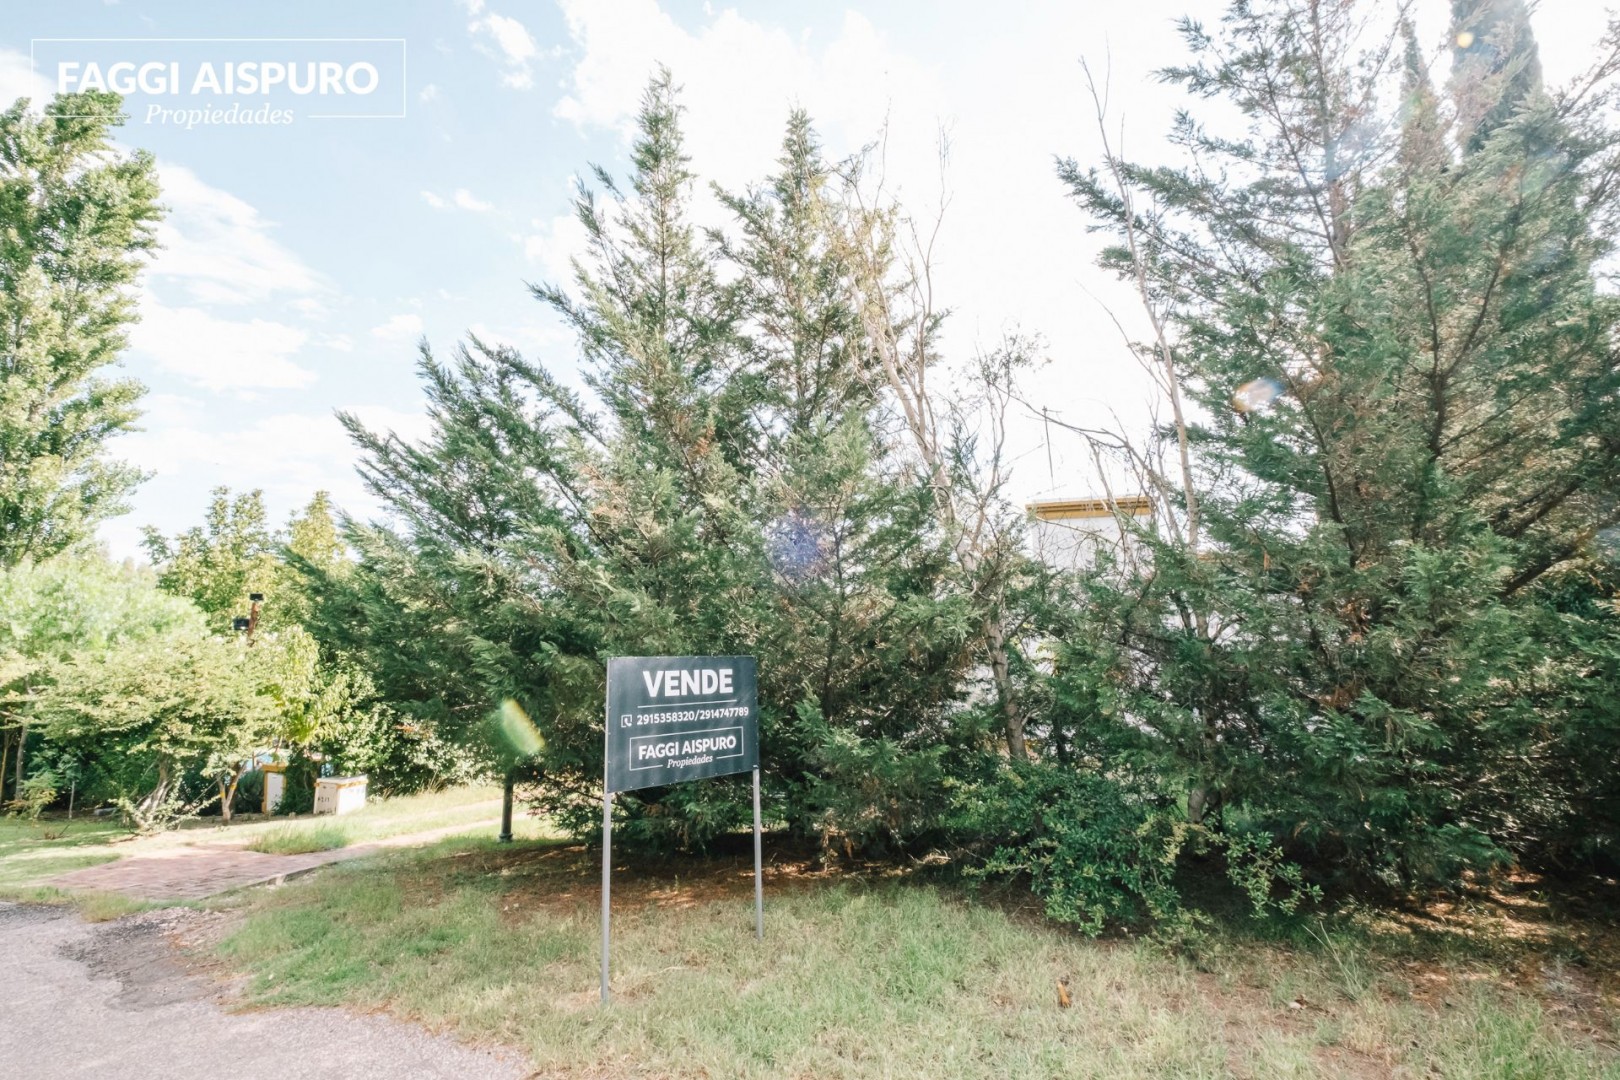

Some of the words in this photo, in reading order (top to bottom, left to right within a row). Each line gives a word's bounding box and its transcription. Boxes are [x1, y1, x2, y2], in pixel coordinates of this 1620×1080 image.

[643, 669, 733, 697] VENDE
[637, 707, 749, 725] 2915358320/2914747789
[638, 742, 679, 760] FAGGI
[681, 735, 737, 755] AISPURO
[667, 755, 713, 768] Propiedades
